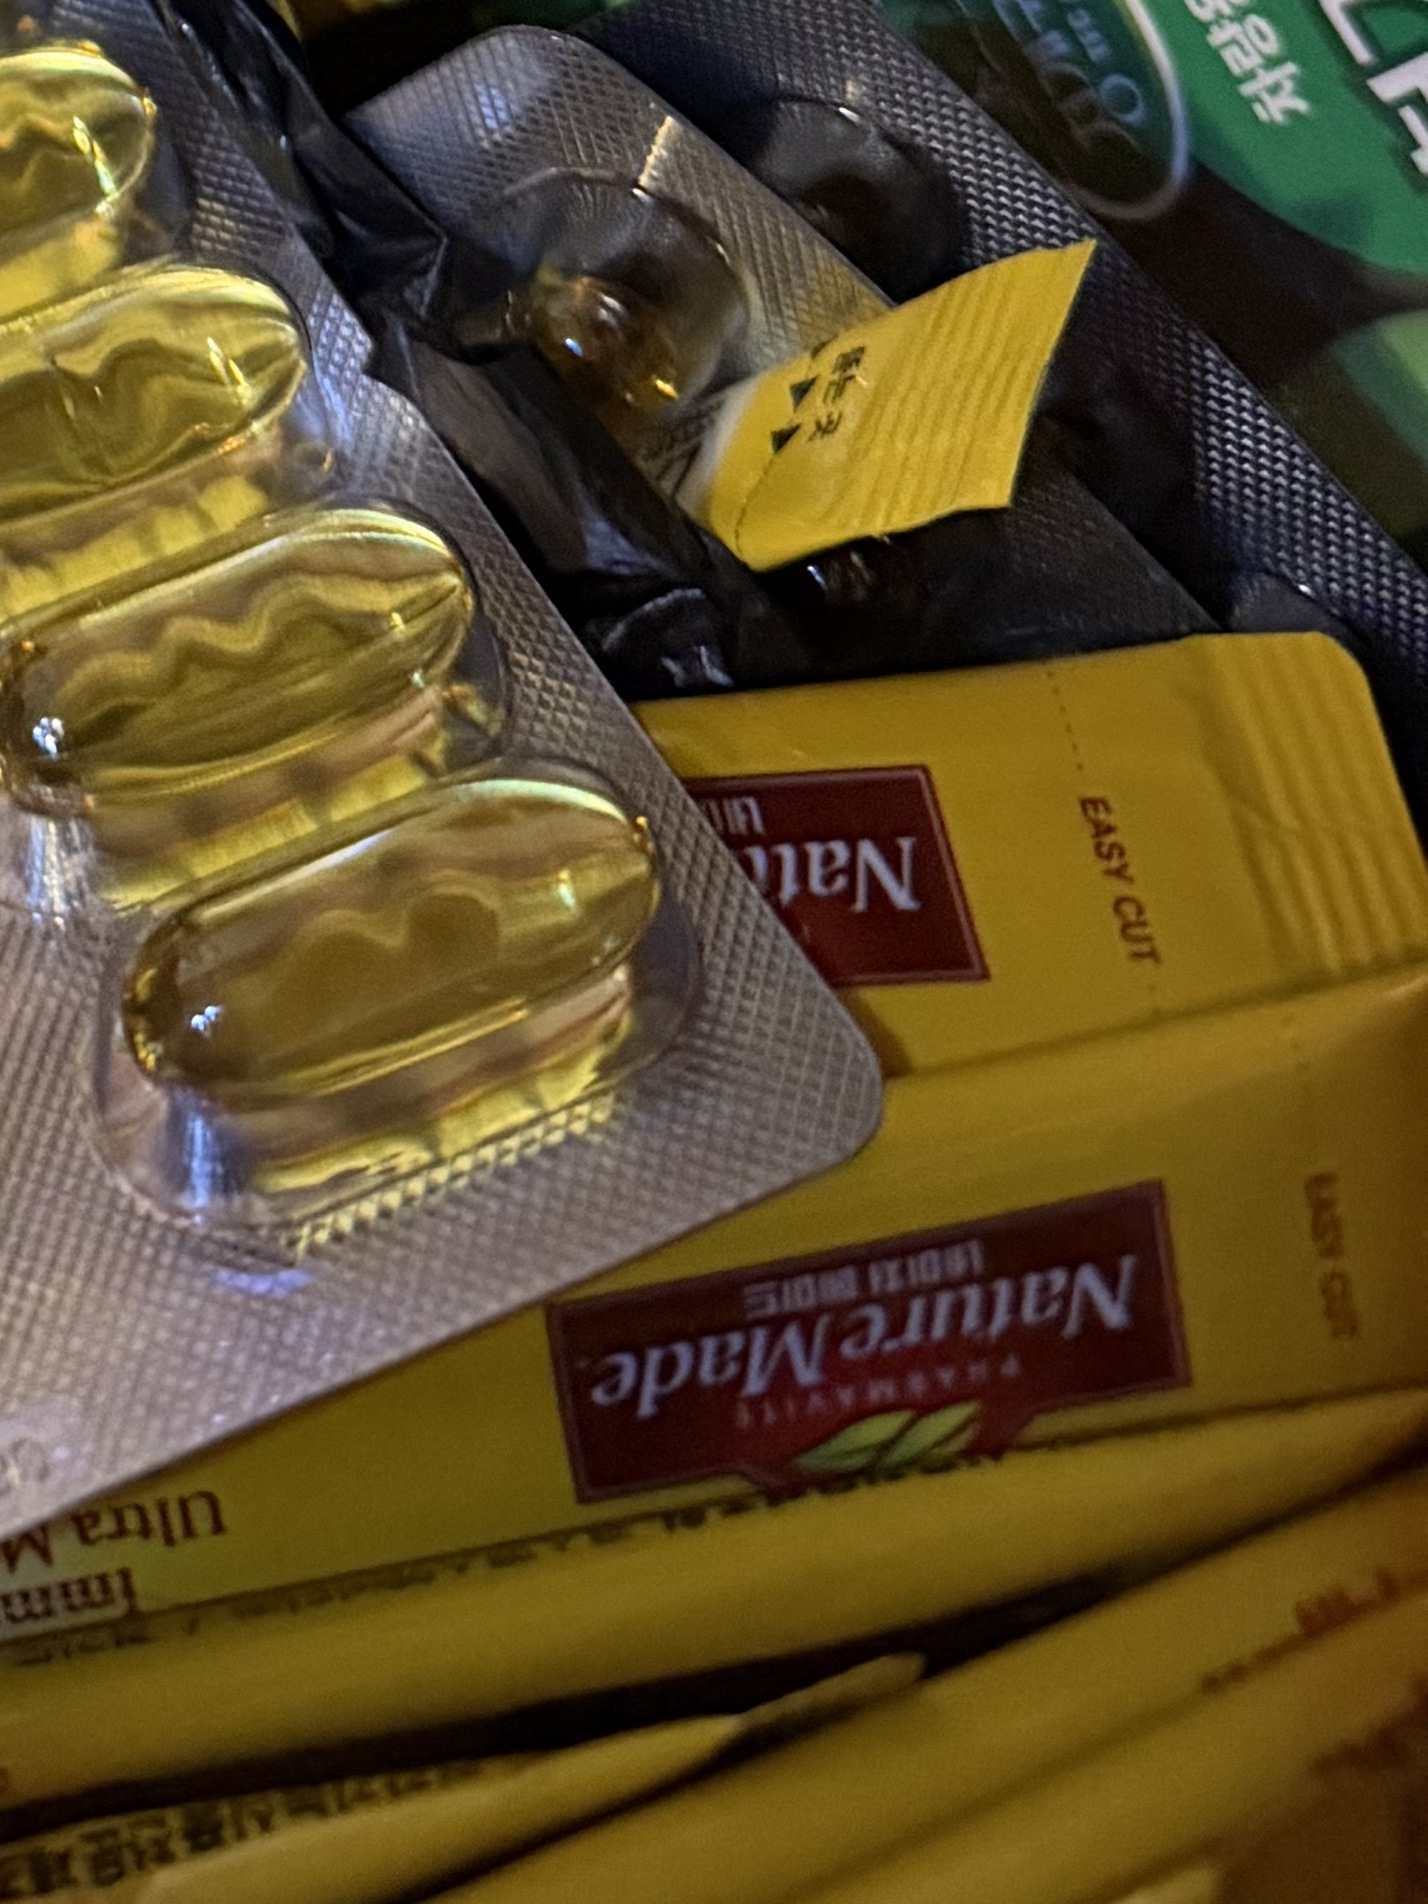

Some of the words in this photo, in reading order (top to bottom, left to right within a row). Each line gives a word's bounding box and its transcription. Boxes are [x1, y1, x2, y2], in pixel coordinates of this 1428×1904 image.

[1077, 791, 1136, 888] EASY
[1110, 891, 1161, 972] CUT
[1303, 1170, 1351, 1259] EASY
[738, 1263, 863, 1322] 메이드
[864, 1236, 988, 1298] 네이처
[1315, 1260, 1365, 1341] CUT
[832, 1249, 1149, 1384] Nature
[580, 1310, 840, 1430] Made
[729, 1349, 1024, 1432] PHARMAVITE
[67, 1483, 229, 1563] Ultra
